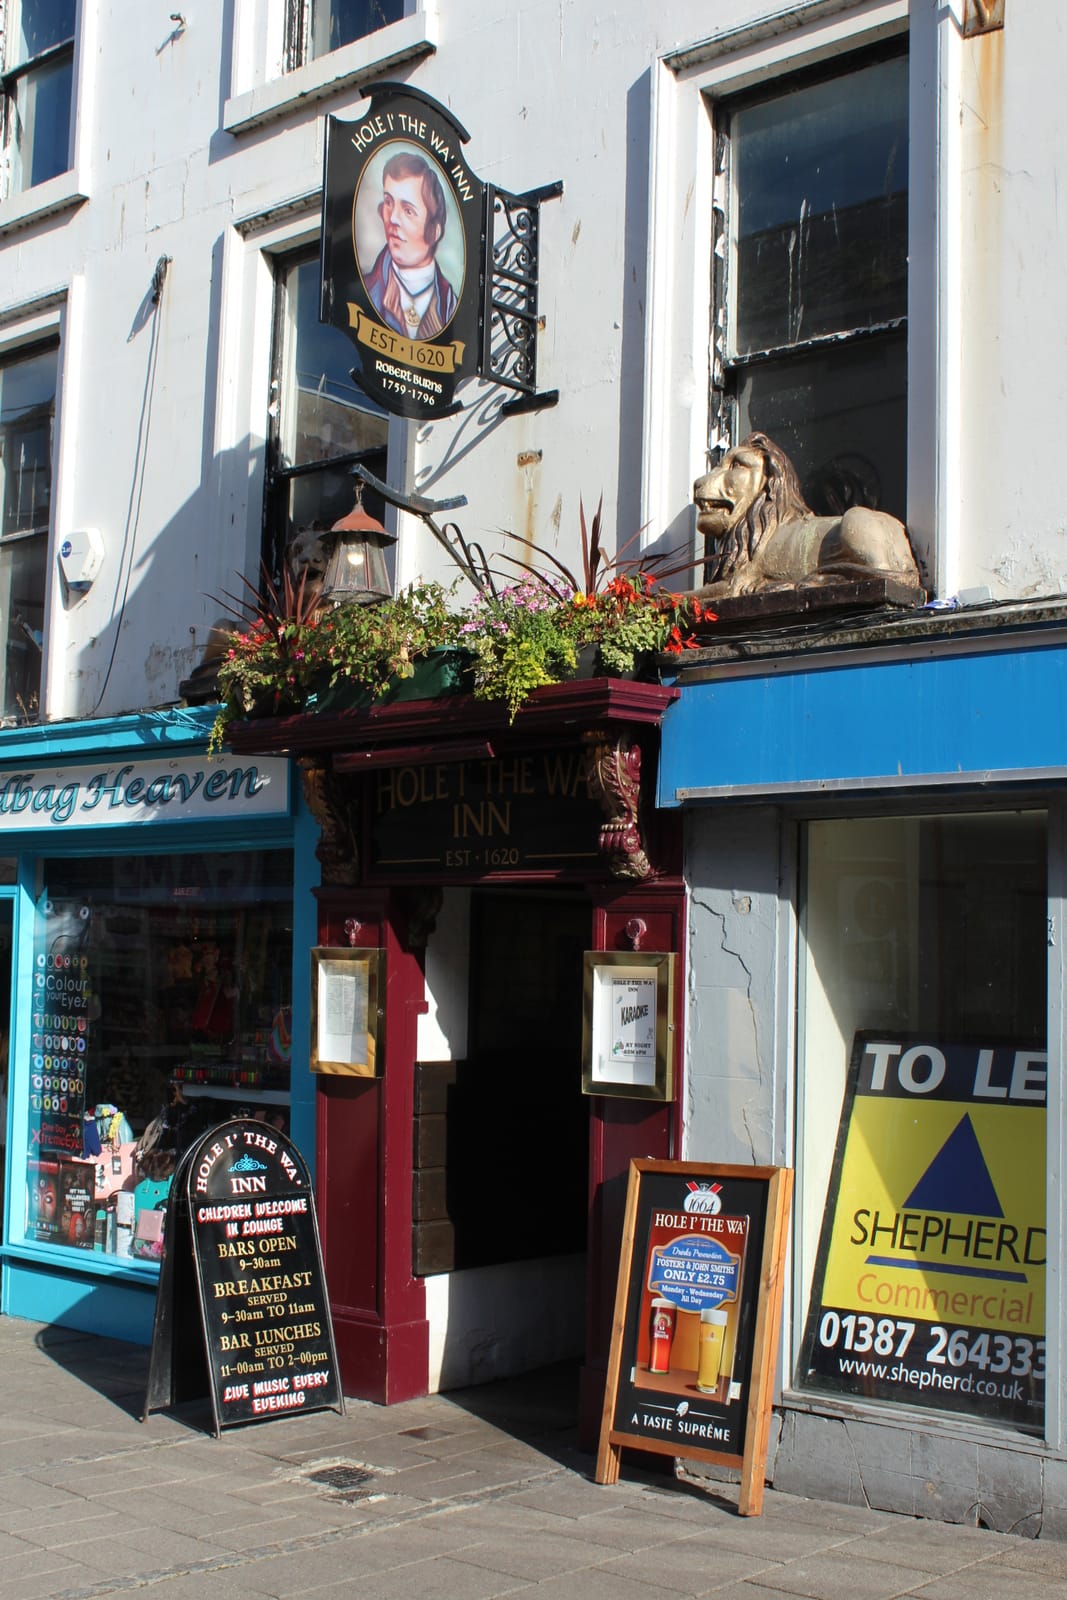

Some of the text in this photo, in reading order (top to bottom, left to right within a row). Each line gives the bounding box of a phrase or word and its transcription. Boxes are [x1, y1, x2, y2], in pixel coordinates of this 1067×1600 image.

[351, 113, 474, 201] HOLE I' THE WA' INN
[369, 328, 445, 367] EST 1620
[375, 360, 443, 394] ROBERT BURNS
[82, 765, 264, 809] Heaven
[376, 765, 450, 812] HOLE
[482, 757, 537, 796] THE
[452, 800, 512, 839] INN
[445, 848, 520, 868] EST 1620
[46, 975, 88, 992] Colour
[62, 992, 88, 1010] Eyez
[621, 1005, 648, 1026] KARAOKE
[865, 1042, 946, 1094] TO
[196, 1142, 224, 1194] HOLE
[224, 1134, 238, 1148] I'
[244, 1132, 278, 1155] THE
[230, 1176, 266, 1194] INN
[198, 1198, 308, 1223] CHILDREN WELCOME
[688, 1198, 716, 1215] 1664
[226, 1218, 284, 1239] IN LOUNGE
[654, 1214, 746, 1234] HOLE I' THE WA'
[218, 1236, 298, 1258] BARS OPEN
[850, 1208, 1047, 1266] SHEPHERD
[692, 1249, 722, 1260] Promotion
[656, 1258, 734, 1274] FOSTERS & JOHN SMITHS
[213, 1272, 312, 1298] BREAKFAST
[664, 1269, 725, 1286] ONLY £2.75
[247, 1292, 288, 1307] SERVED
[662, 1284, 685, 1296] Monday
[690, 1288, 724, 1300] Wednesday
[690, 1296, 702, 1304] Day
[856, 1273, 1034, 1325] Commercial
[266, 1304, 285, 1318] TO
[288, 1302, 316, 1315] 11am
[220, 1322, 322, 1351] BAR LUNCHES
[819, 1311, 916, 1358] 01387
[254, 1342, 294, 1358] SERVED
[267, 1356, 284, 1370] TO
[224, 1370, 330, 1403] LIVE MUSIC EVERY
[838, 1358, 1024, 1401] www.shepherd.co.uk
[252, 1391, 306, 1414] EVENING
[632, 1412, 730, 1442] A TASTE SUPRÊME
